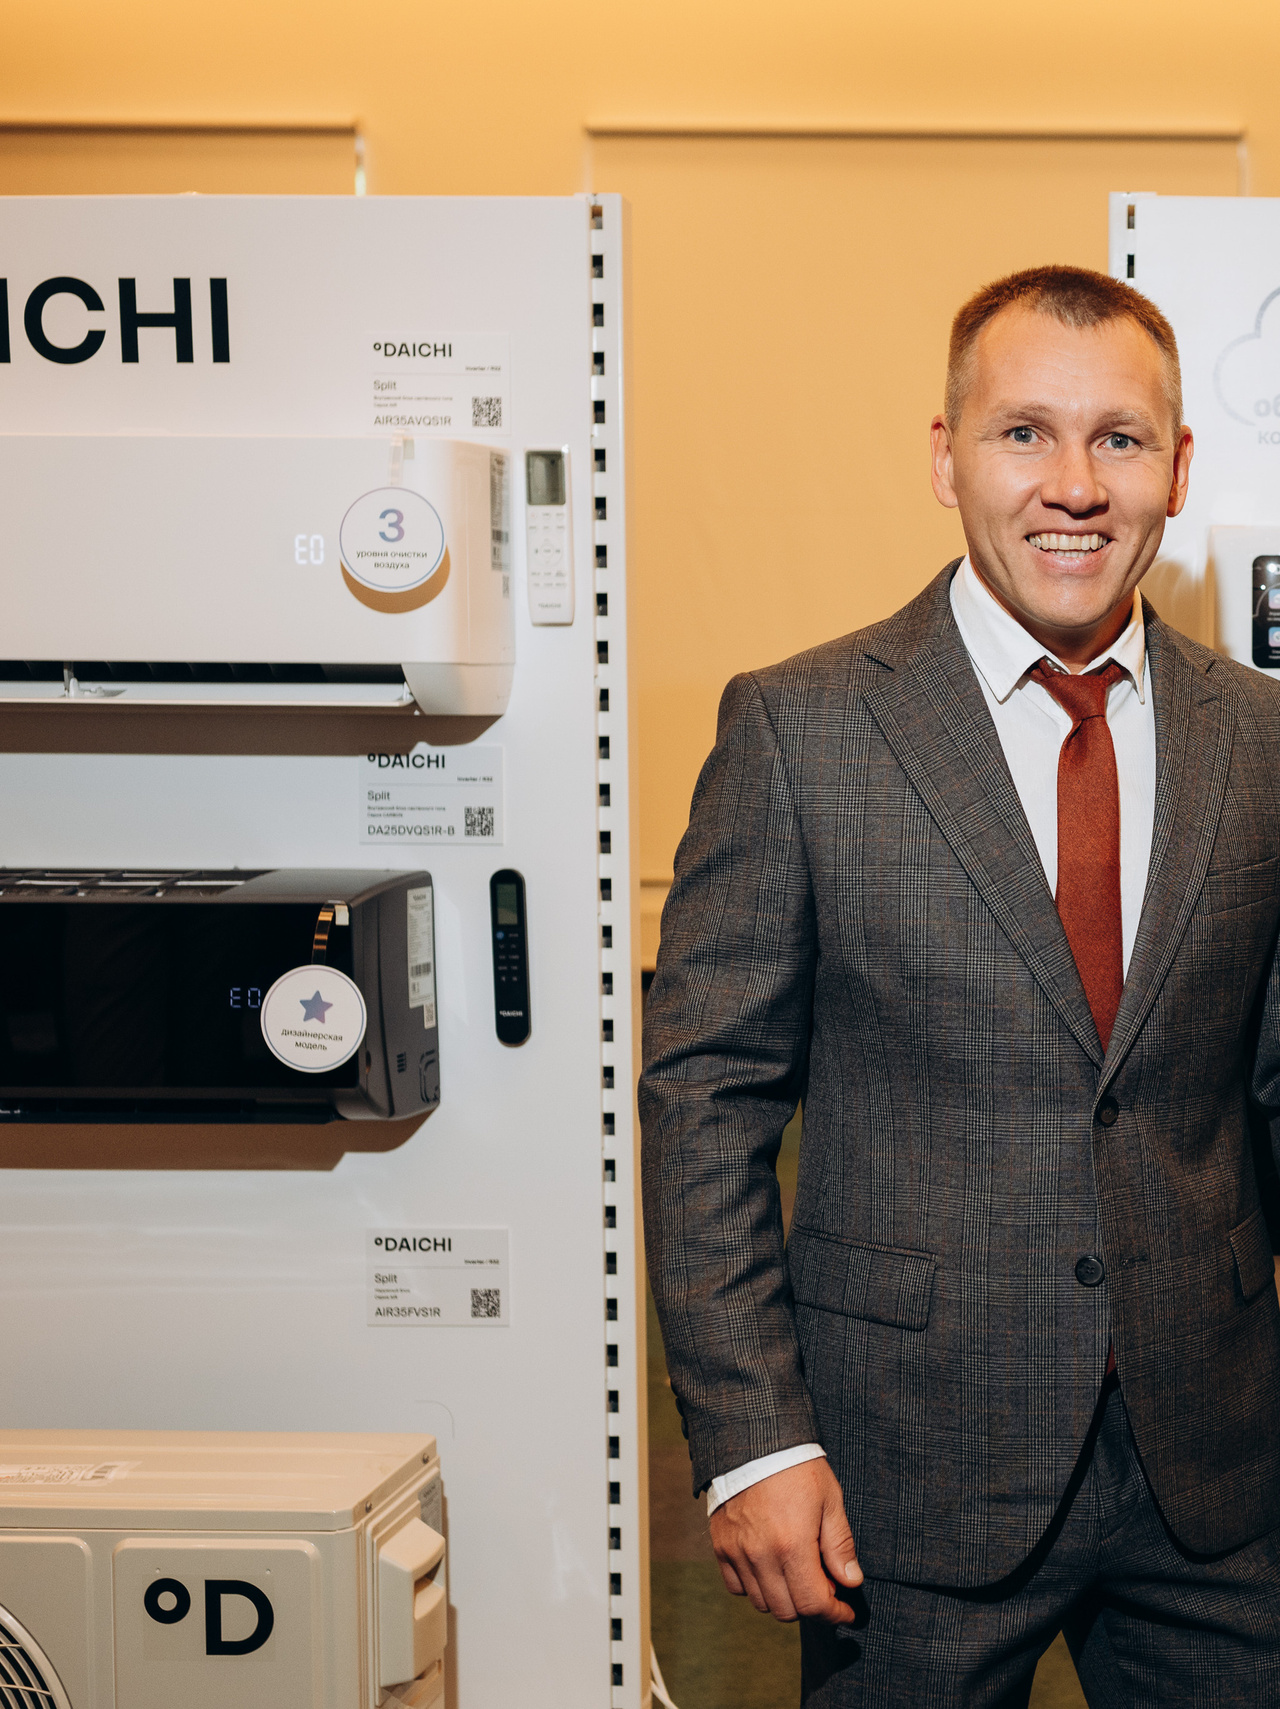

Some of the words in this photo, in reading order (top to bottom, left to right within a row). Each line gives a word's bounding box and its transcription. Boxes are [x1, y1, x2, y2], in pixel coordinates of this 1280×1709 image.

[373, 380, 397, 391] Split
[378, 508, 405, 543] 3
[356, 550, 389, 559] уровня
[390, 550, 427, 558] очистки
[367, 790, 391, 802] Split
[281, 1028, 343, 1042] дизайнерская
[294, 1041, 328, 1051] модель
[374, 1273, 398, 1285] Split
